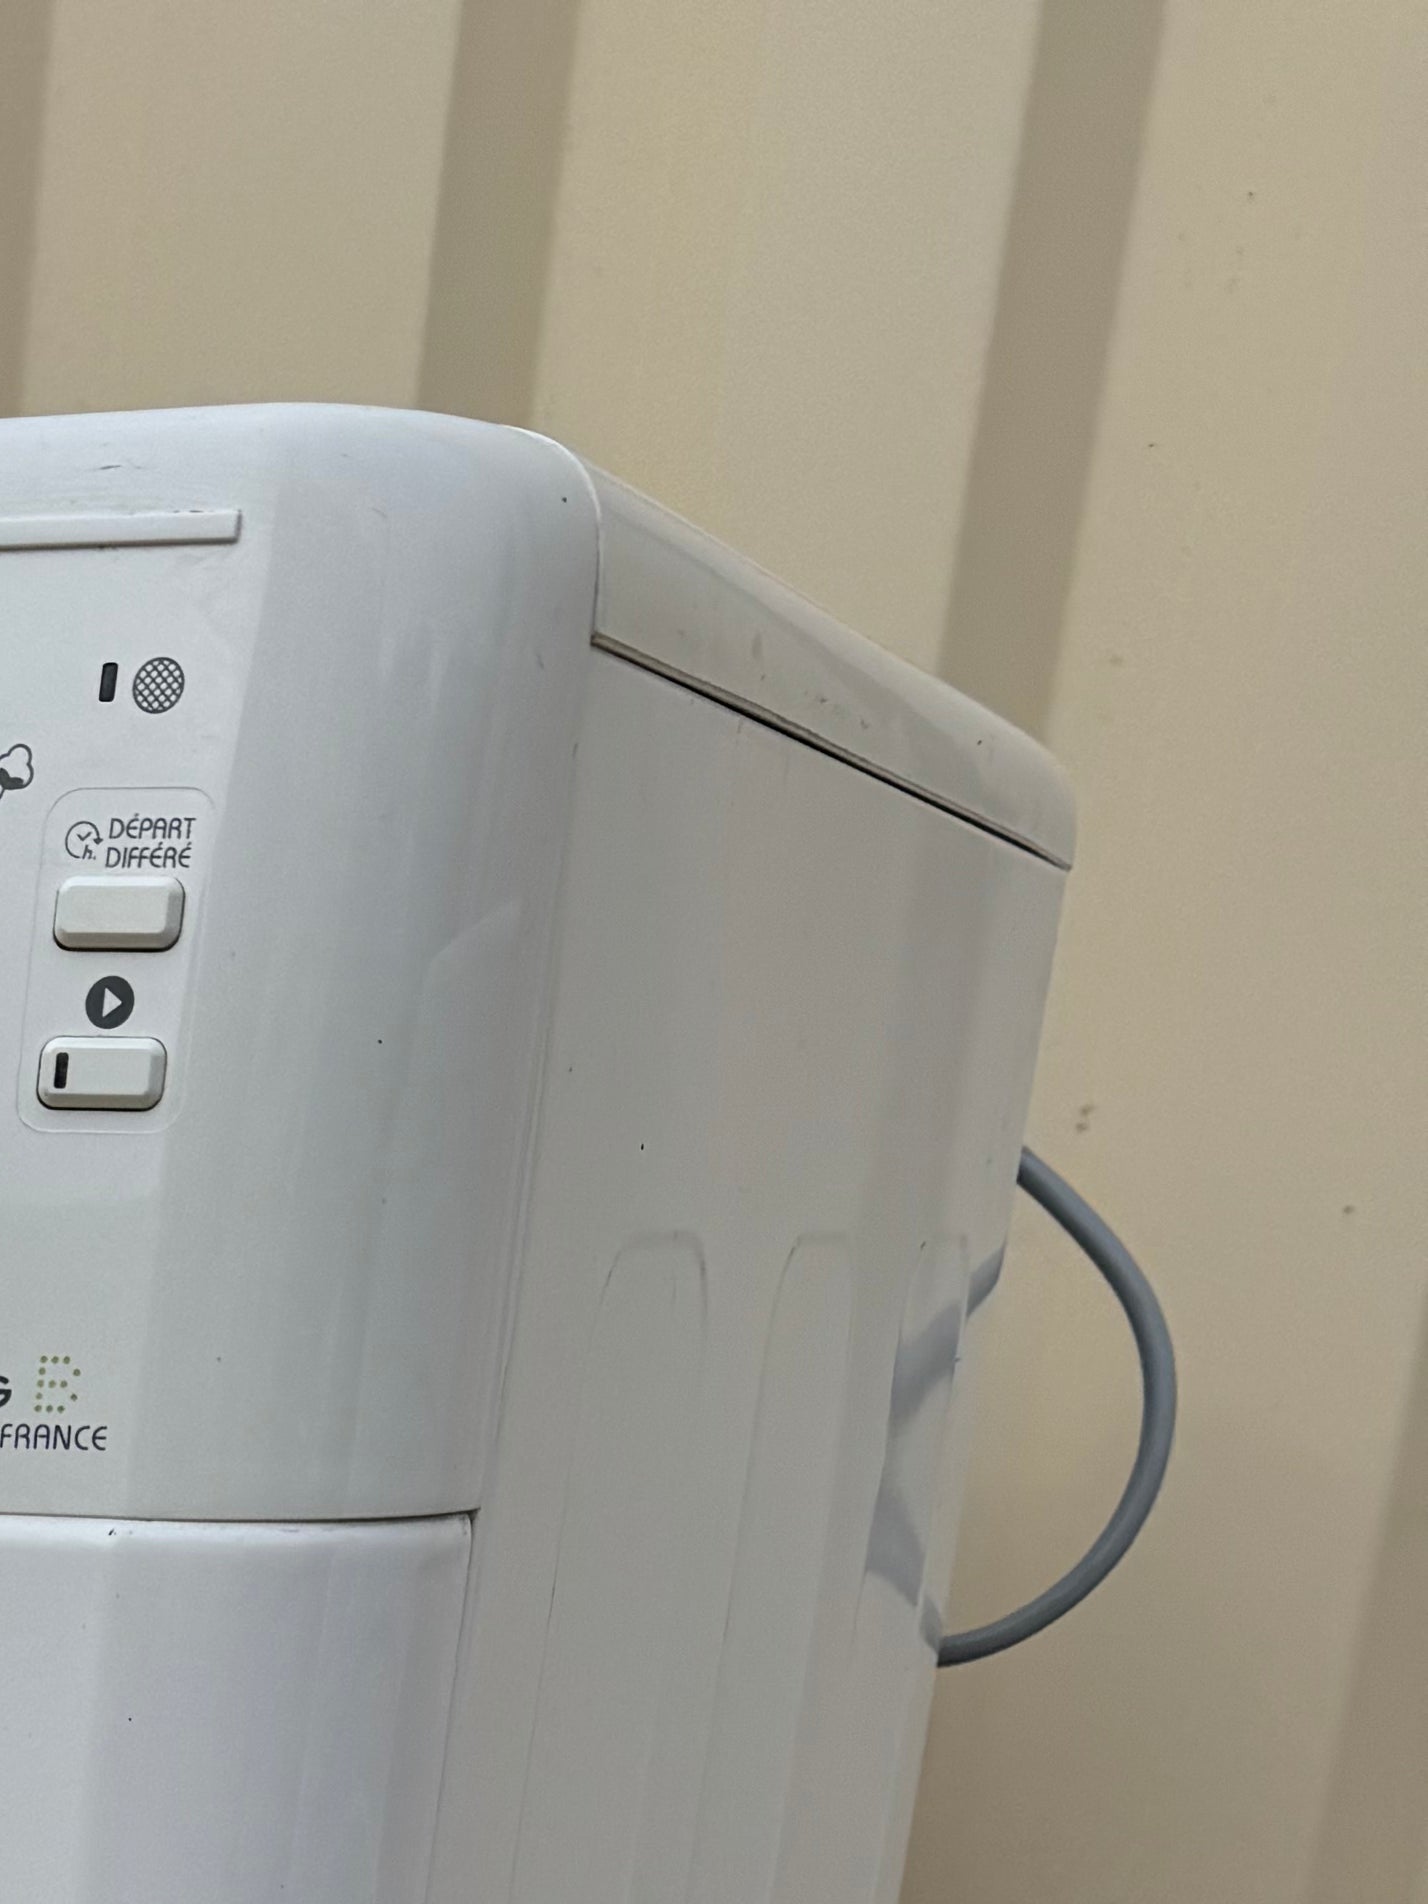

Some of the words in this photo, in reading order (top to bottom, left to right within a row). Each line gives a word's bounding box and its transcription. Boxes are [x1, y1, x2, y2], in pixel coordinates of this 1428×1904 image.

[108, 812, 197, 840] DÉPART
[104, 841, 192, 869] DIFFÉRÉ
[0, 1422, 108, 1452] FRANCE
